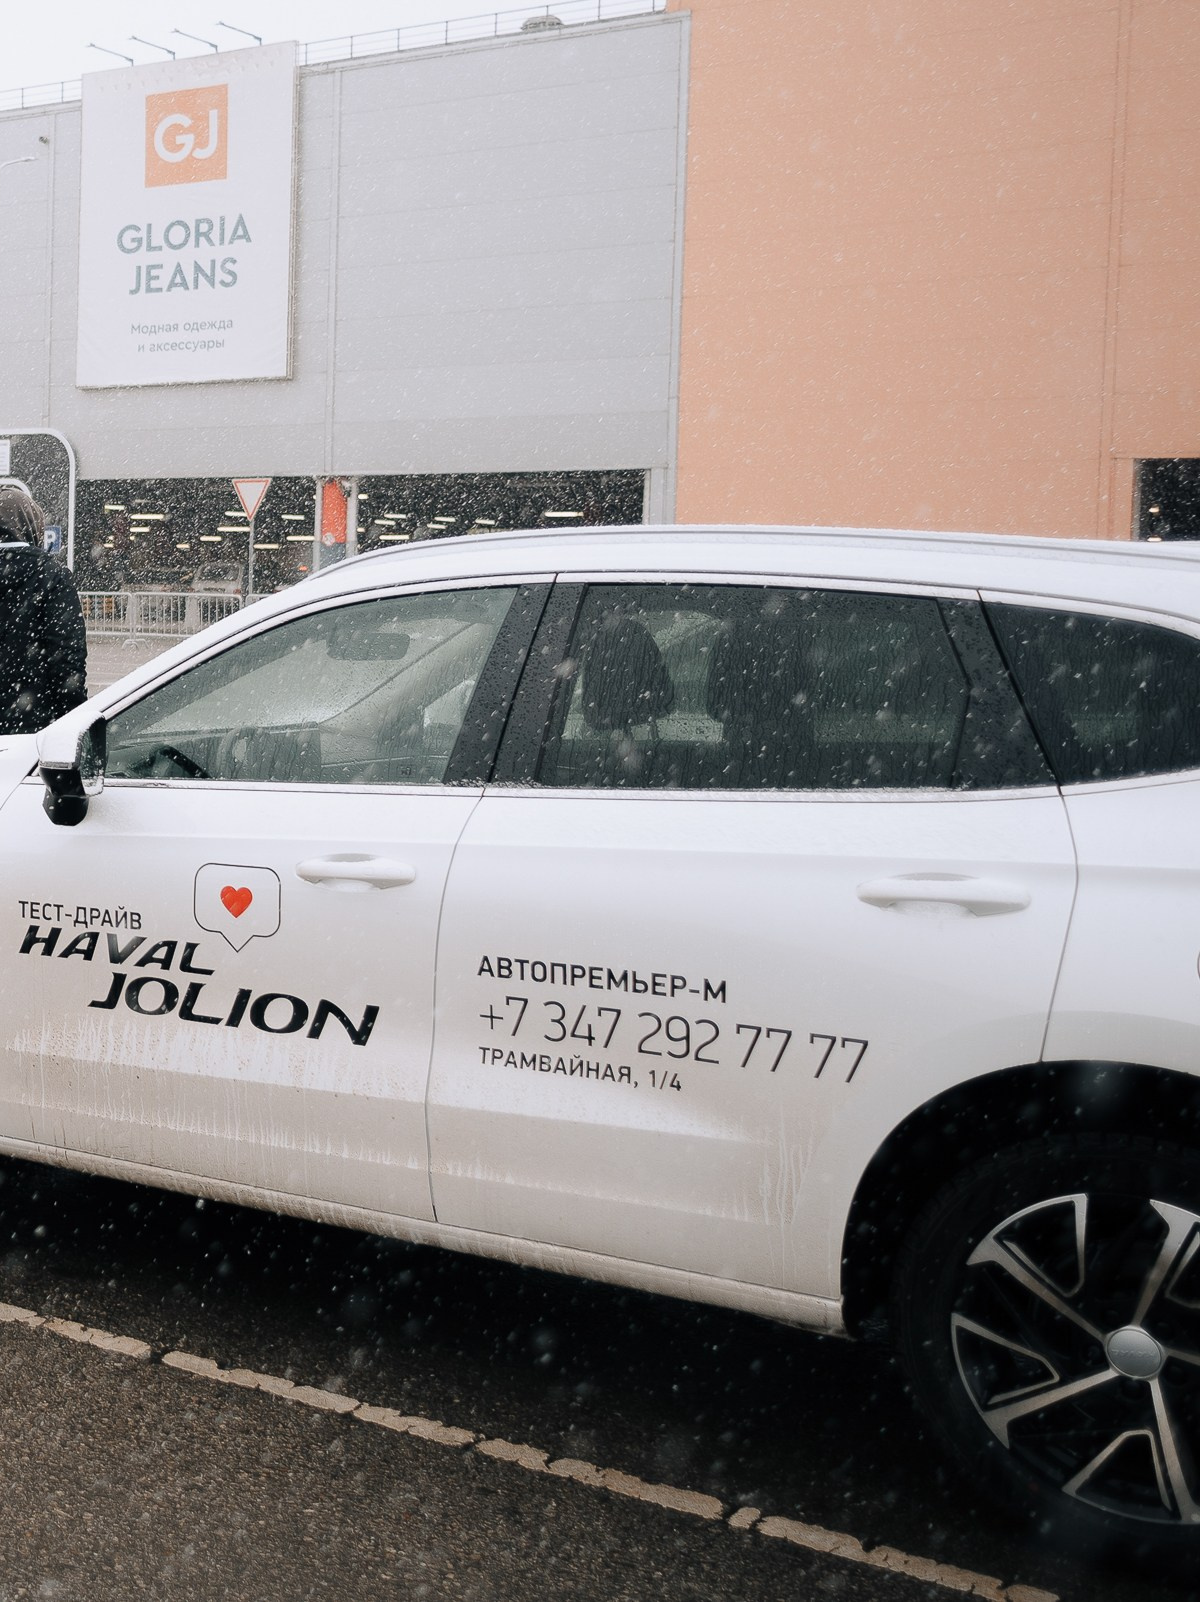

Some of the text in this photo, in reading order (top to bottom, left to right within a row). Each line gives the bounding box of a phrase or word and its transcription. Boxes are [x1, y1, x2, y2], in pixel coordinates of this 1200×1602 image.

[153, 108, 218, 164] GJ
[116, 213, 252, 255] GLORIA
[129, 257, 238, 296] JEANS
[130, 319, 234, 336] Модная одежда
[137, 339, 225, 352] и аксессуары
[44, 530, 56, 551] P
[18, 900, 142, 930] ТЕСТ-ДРАЙВ
[18, 925, 215, 975] HAVAL
[477, 955, 727, 1003] АВТОПРЕМЬЕР-М
[87, 972, 380, 1046] JOLION
[479, 995, 869, 1083] +7 347 292 77 77
[478, 1046, 682, 1092] ТРАМВАЙНАЯ, 1/4
